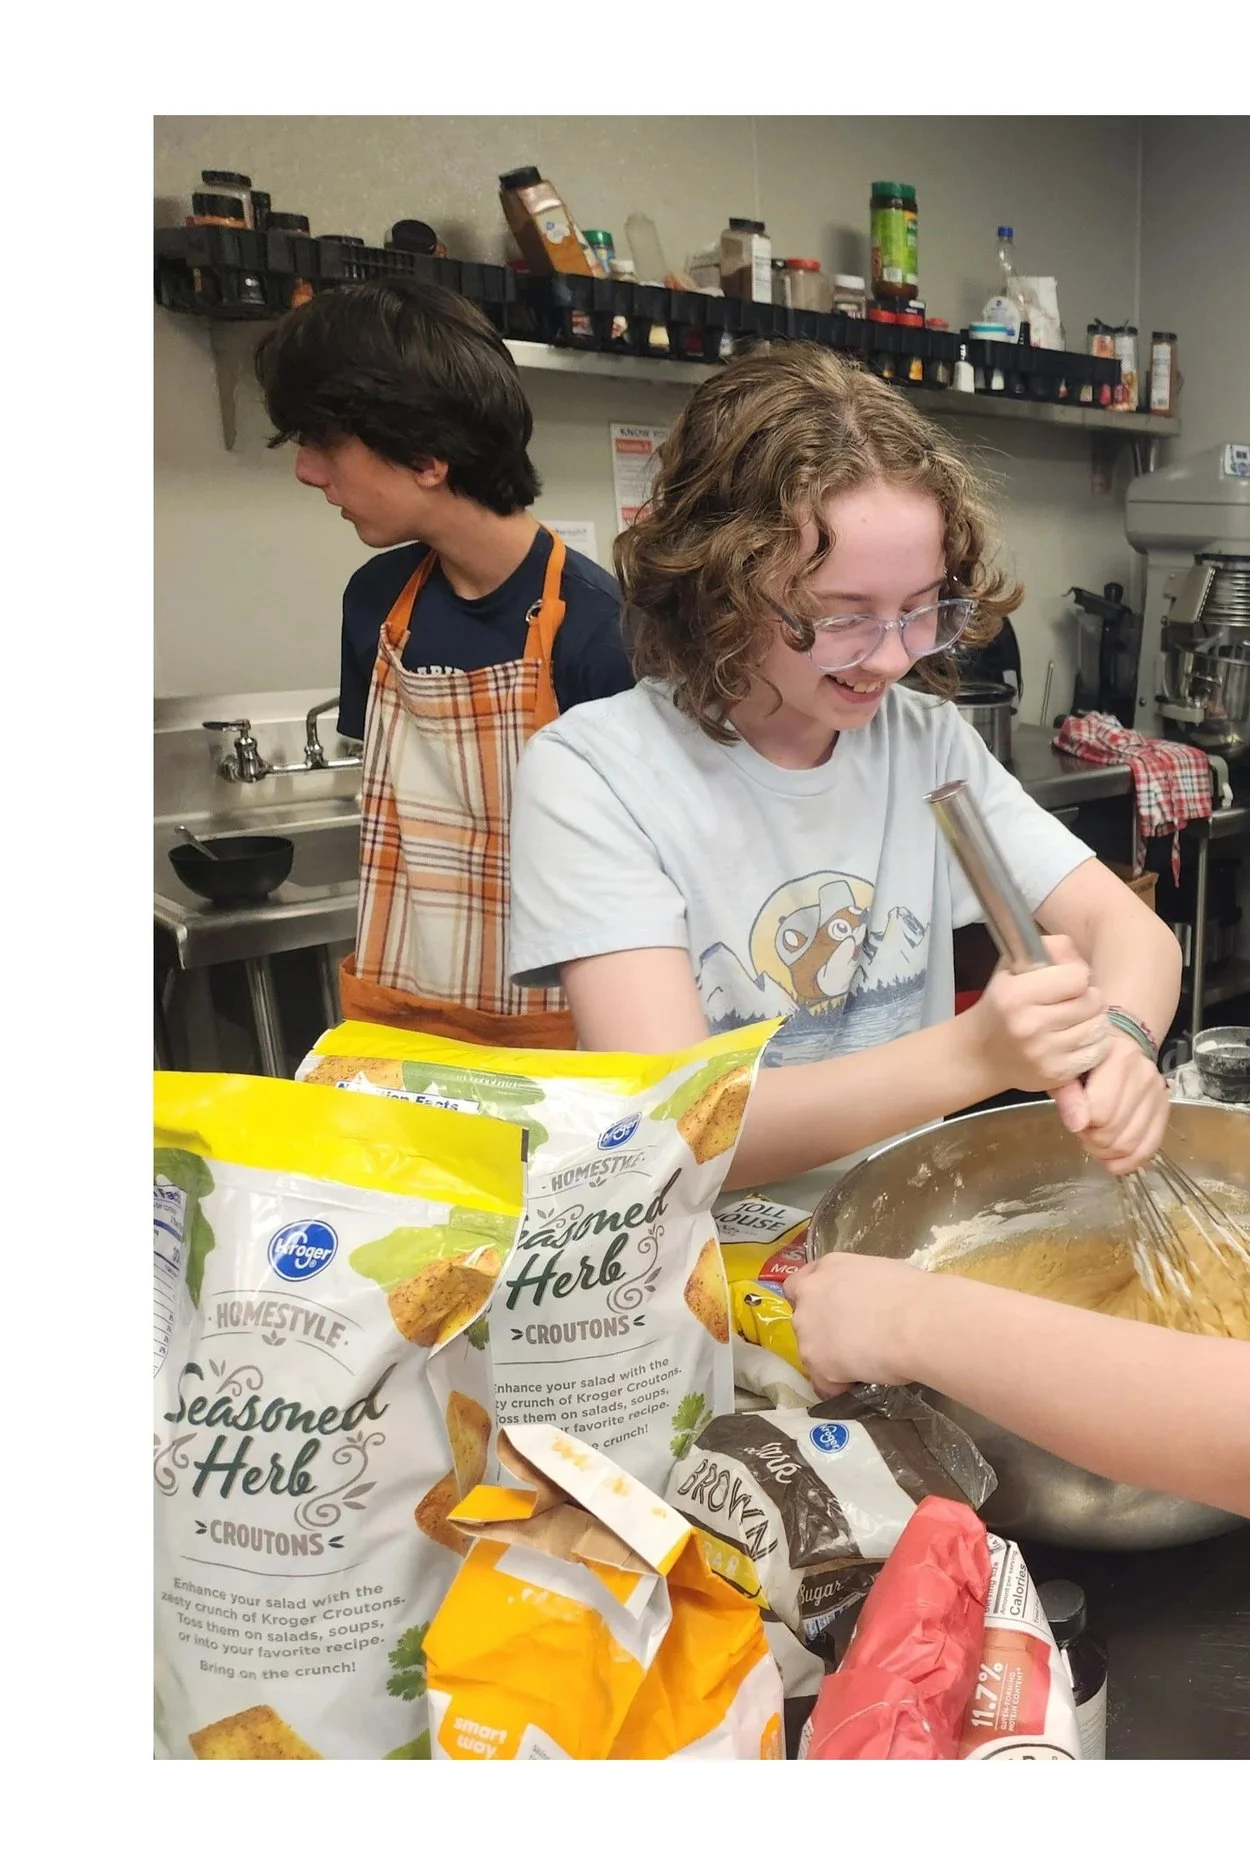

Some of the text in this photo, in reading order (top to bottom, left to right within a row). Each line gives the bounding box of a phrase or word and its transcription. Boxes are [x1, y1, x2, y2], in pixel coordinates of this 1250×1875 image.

[517, 1168, 682, 1250] easoned
[735, 1202, 787, 1219] TOLL
[275, 1230, 333, 1270] Kroger
[505, 1232, 629, 1311] Herb
[216, 1300, 346, 1348] HOMESTYLE
[525, 1315, 630, 1345] CROUTONS
[511, 1397, 554, 1409] crunch
[559, 1395, 573, 1406] of
[577, 1387, 623, 1404] Kroger
[626, 1367, 682, 1394] Croutons.
[546, 1380, 576, 1396] your
[581, 1373, 616, 1388] salad
[620, 1364, 646, 1381] with
[649, 1357, 669, 1372] the
[163, 1362, 399, 1436] Seasoned
[523, 1413, 557, 1423] them
[561, 1408, 578, 1420] on
[581, 1400, 627, 1418] salads,
[631, 1388, 670, 1407] soups,
[574, 1416, 625, 1433] favorite
[628, 1402, 670, 1421] recipe.
[603, 1423, 649, 1448] crunch!
[191, 1434, 321, 1499] Herb
[677, 1458, 778, 1561] BROWN
[210, 1519, 325, 1557] CROUTONS
[174, 1577, 384, 1610] Enhance your salad with the
[1000, 1586, 1010, 1615] Amount
[1008, 1549, 1019, 1574] serving
[1009, 1563, 1028, 1616] Calories
[161, 1591, 406, 1628] zesty crunch of Kroger Croutons.
[176, 1612, 385, 1643] Toss them on salads, soups,
[178, 1631, 385, 1659] or into your favorite recipe.
[200, 1660, 356, 1681] Bring on the crunch!
[971, 1662, 1003, 1727] 11.7%
[453, 1717, 508, 1744] smart
[457, 1735, 497, 1760] way
